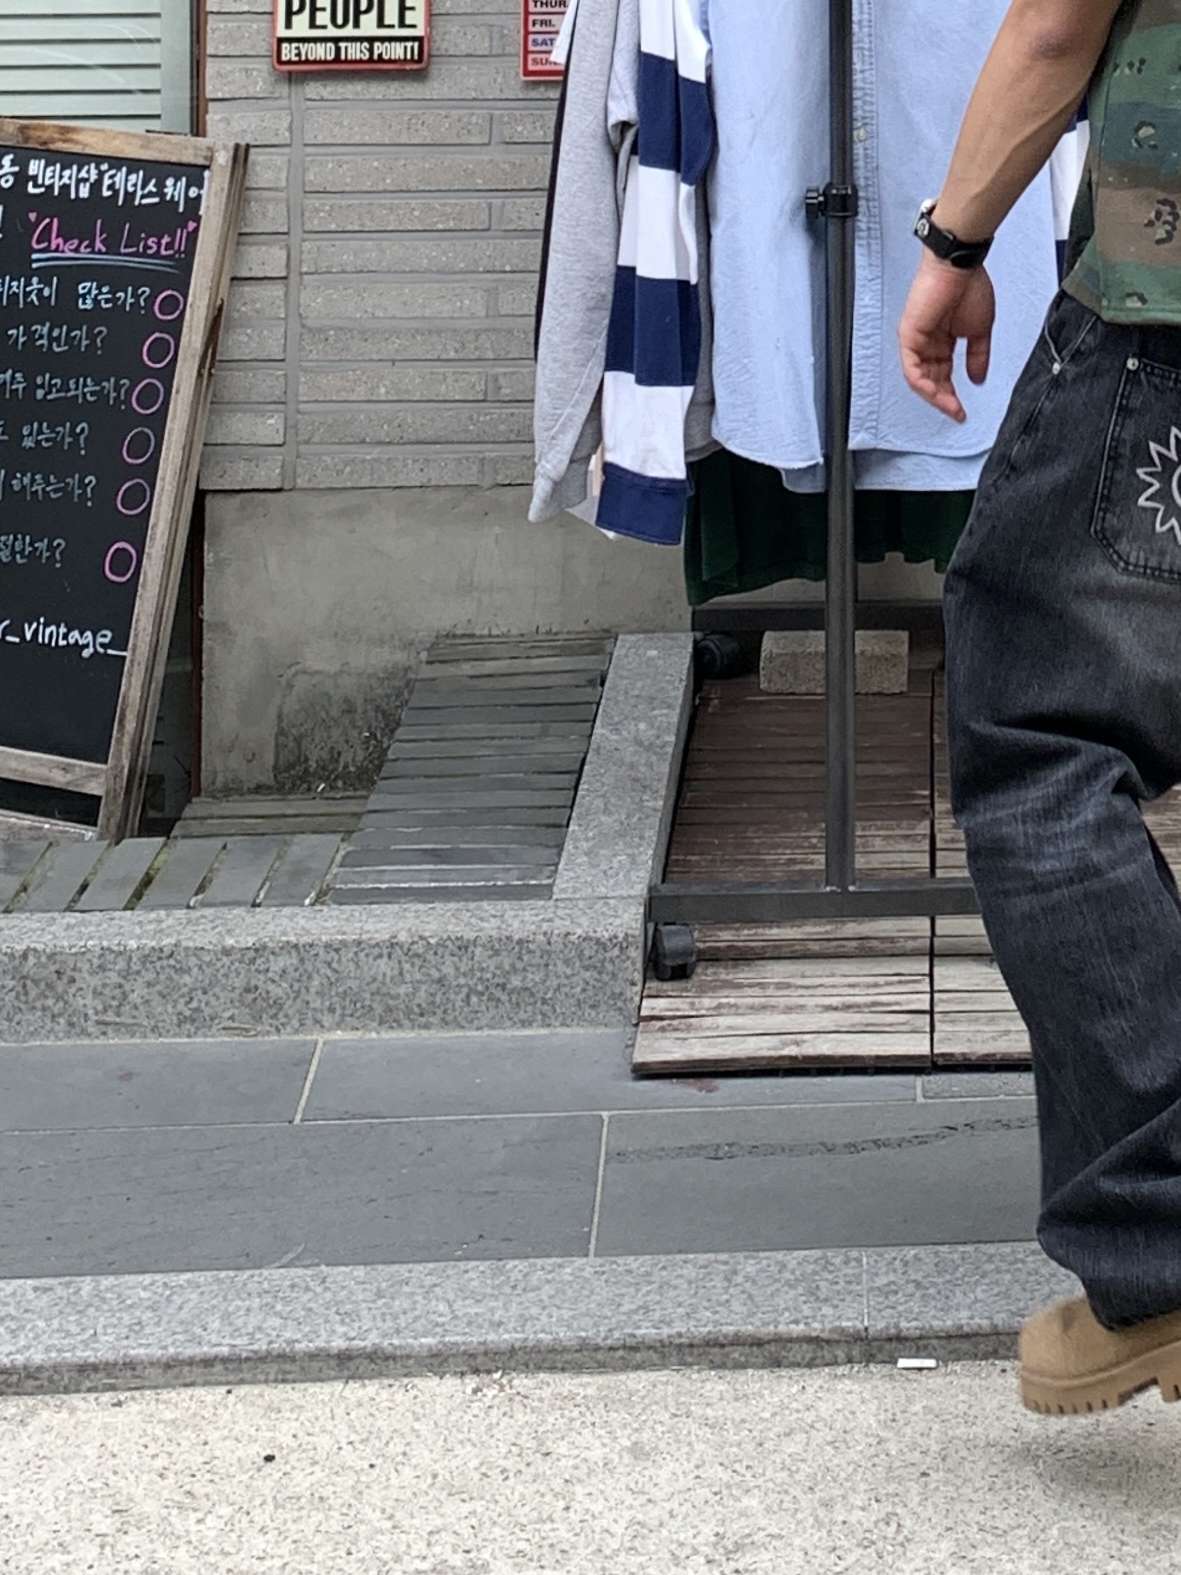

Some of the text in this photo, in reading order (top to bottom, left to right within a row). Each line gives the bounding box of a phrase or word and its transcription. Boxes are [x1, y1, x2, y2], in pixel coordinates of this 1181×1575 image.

[281, 41, 419, 61] BEYOND THIS POINT!
[28, 159, 98, 200] 빈티지샵
[32, 217, 107, 253] Check
[78, 281, 150, 314] 많은가?
[35, 372, 131, 410] 입고되는가?
[22, 421, 89, 455] 있는가?
[11, 472, 97, 507] 해주는가?
